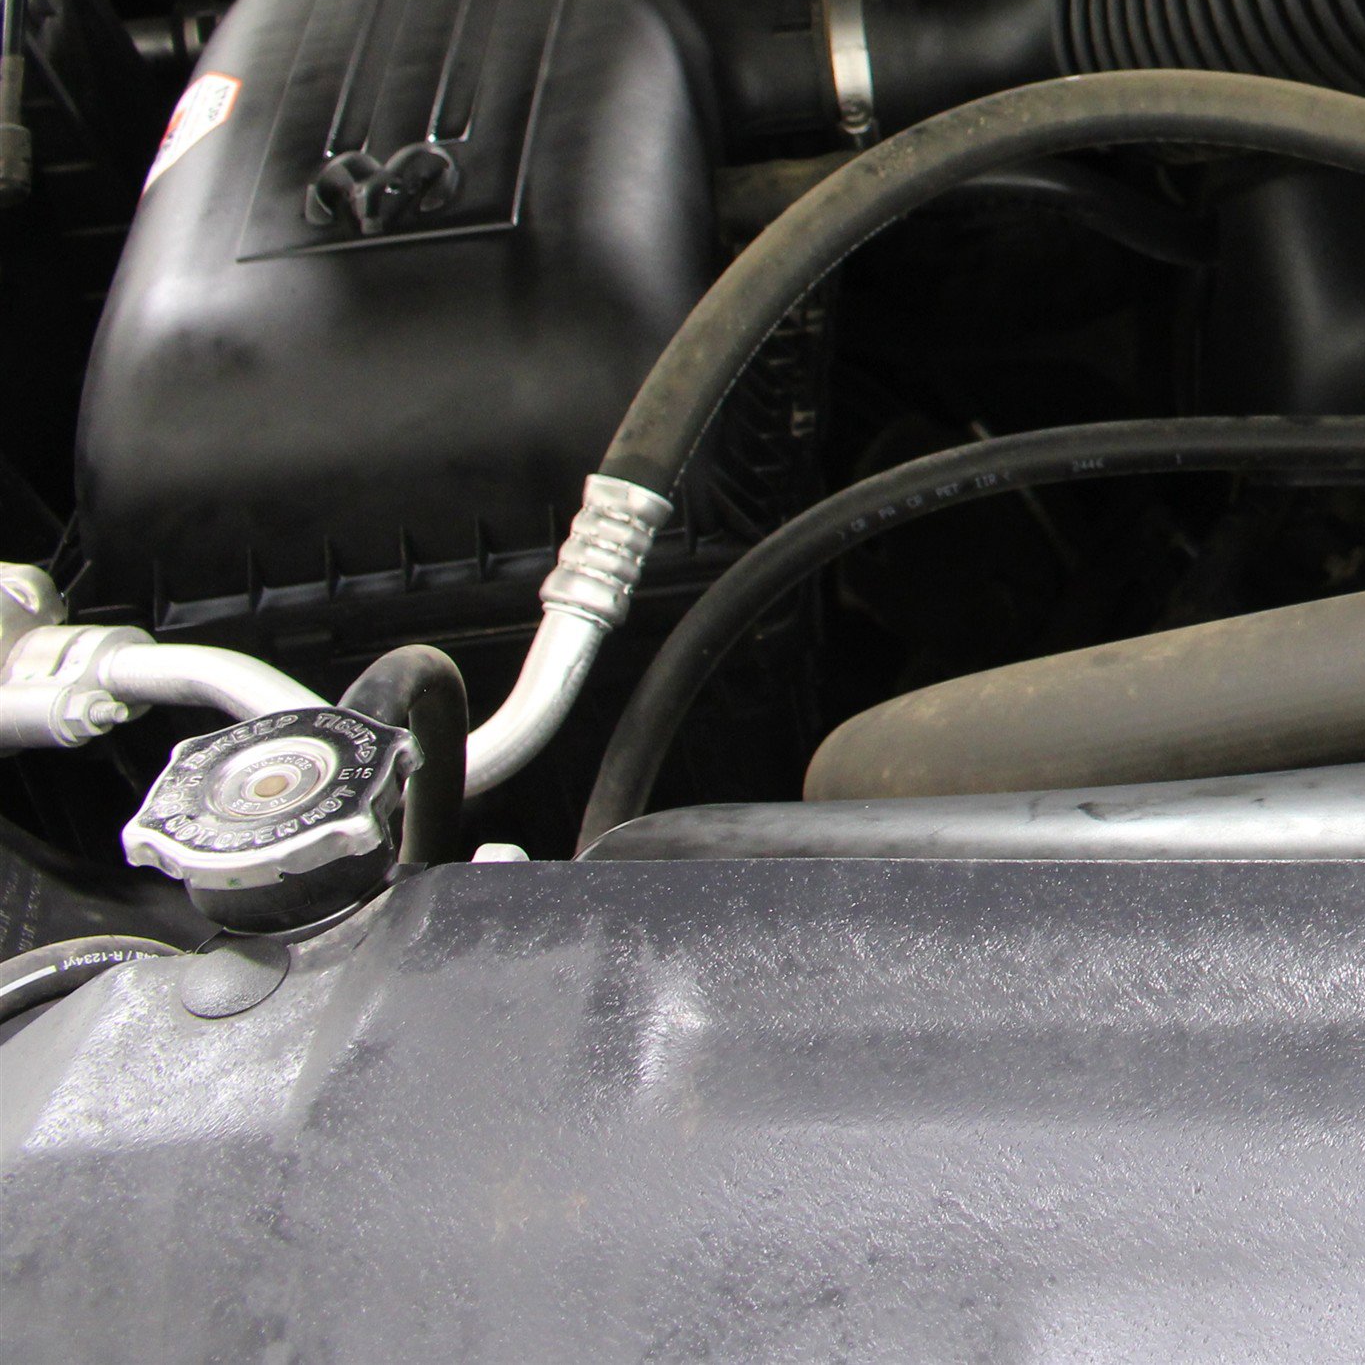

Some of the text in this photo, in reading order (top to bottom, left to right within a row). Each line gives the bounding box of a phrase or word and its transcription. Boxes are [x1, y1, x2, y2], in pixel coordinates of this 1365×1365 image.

[212, 712, 377, 753] KEEP TIGHT
[338, 767, 375, 780] E16
[155, 784, 356, 849] DO NOT OPEN HOT
[62, 949, 124, 971] R-1234yf
